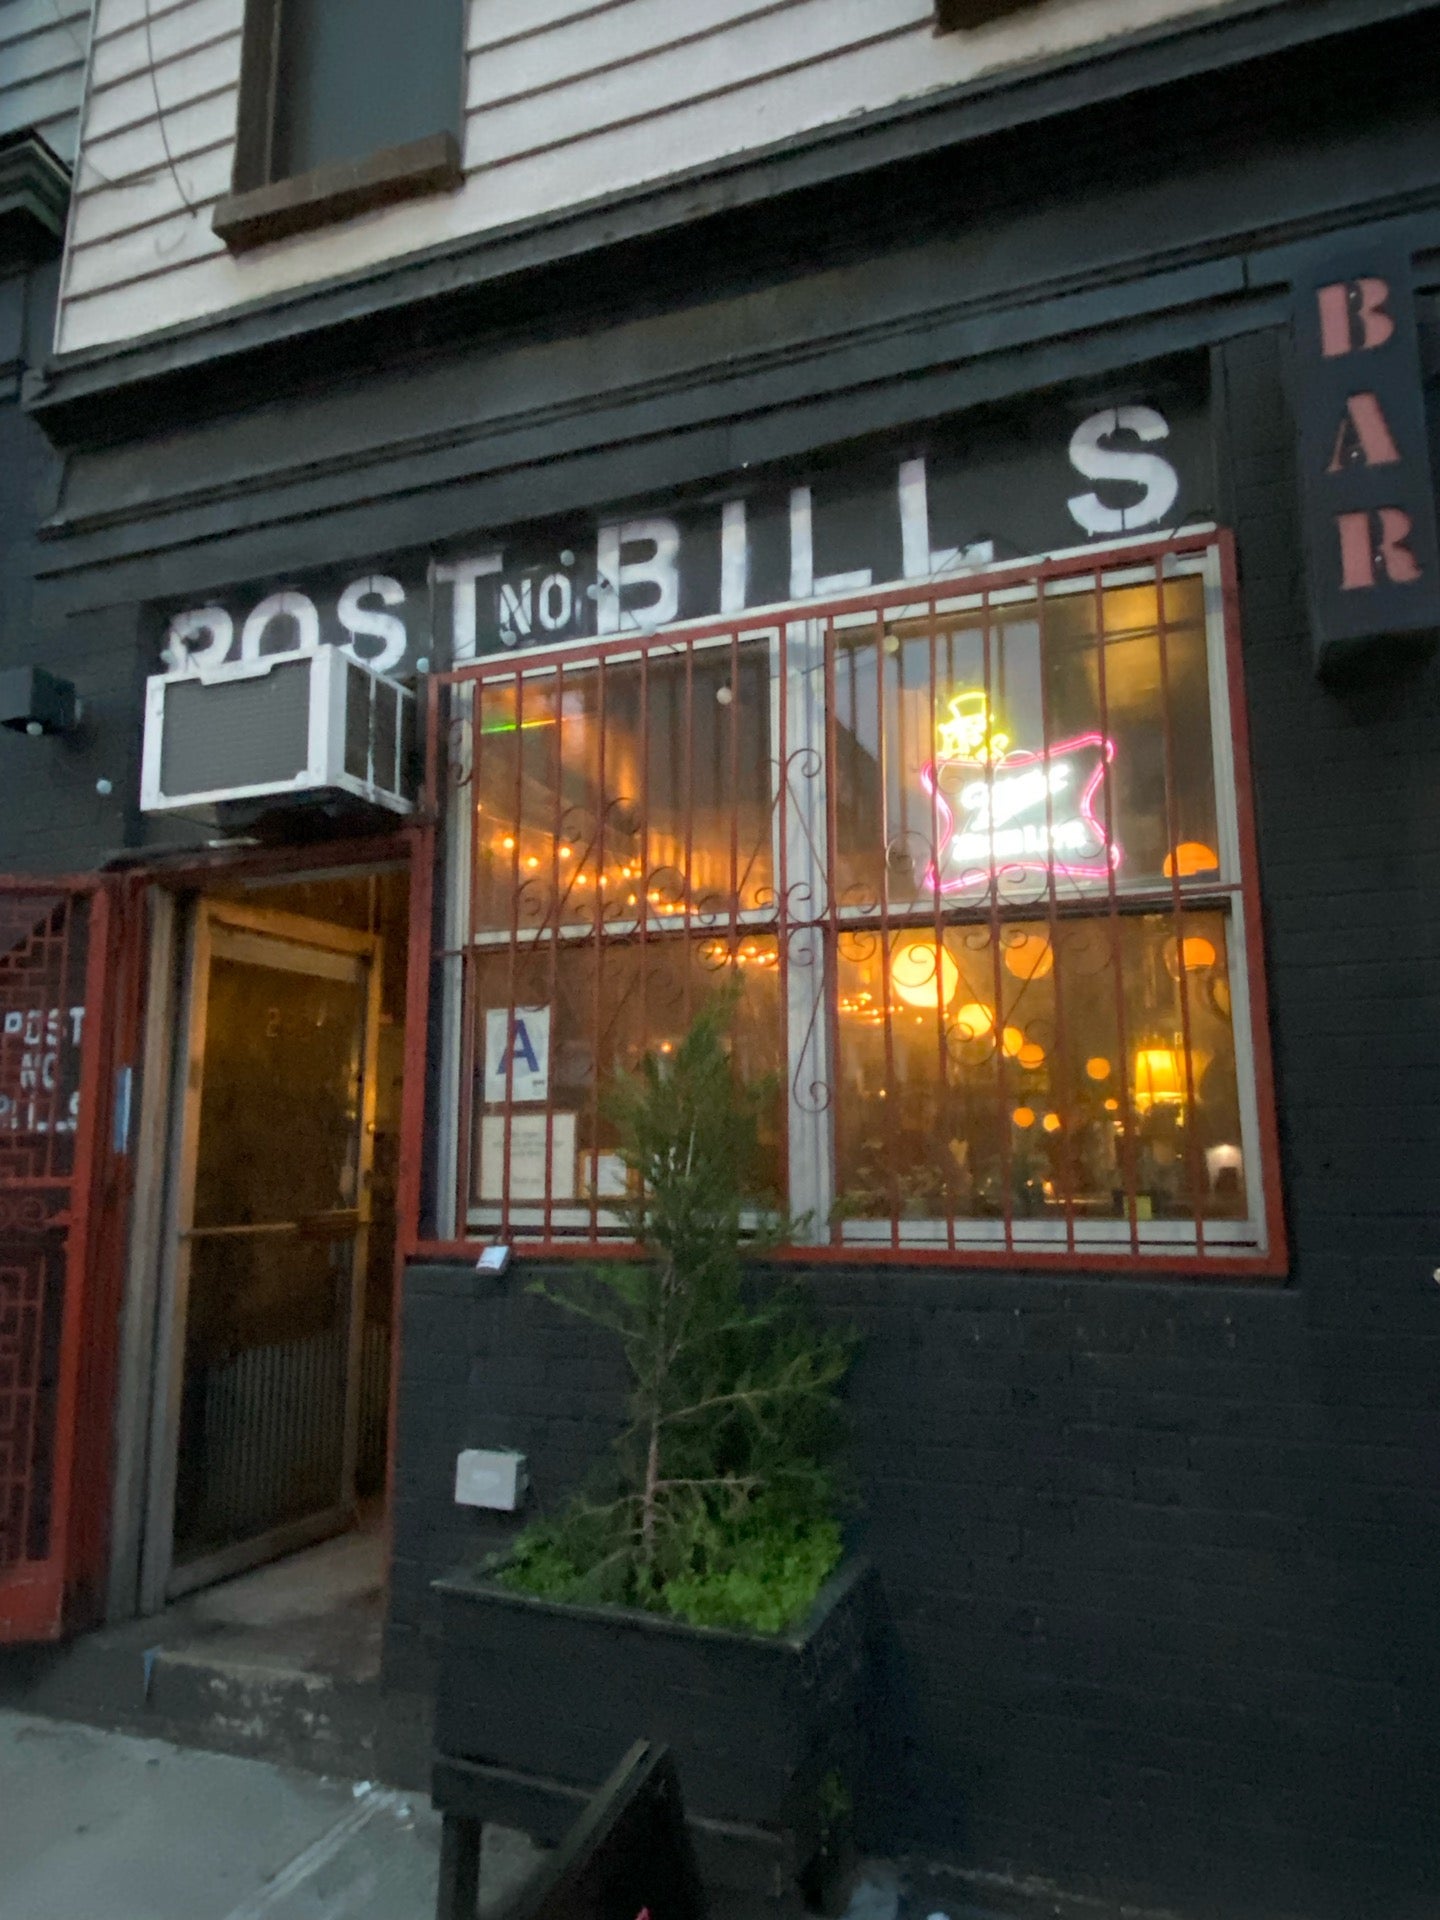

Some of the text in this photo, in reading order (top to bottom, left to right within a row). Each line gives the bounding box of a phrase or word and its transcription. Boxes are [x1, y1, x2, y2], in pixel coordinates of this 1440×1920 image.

[1316, 277, 1423, 591] BAR
[164, 553, 503, 673] POST
[596, 405, 1180, 636] BILLS
[4, 1005, 85, 1045] POST
[496, 1018, 540, 1075] A
